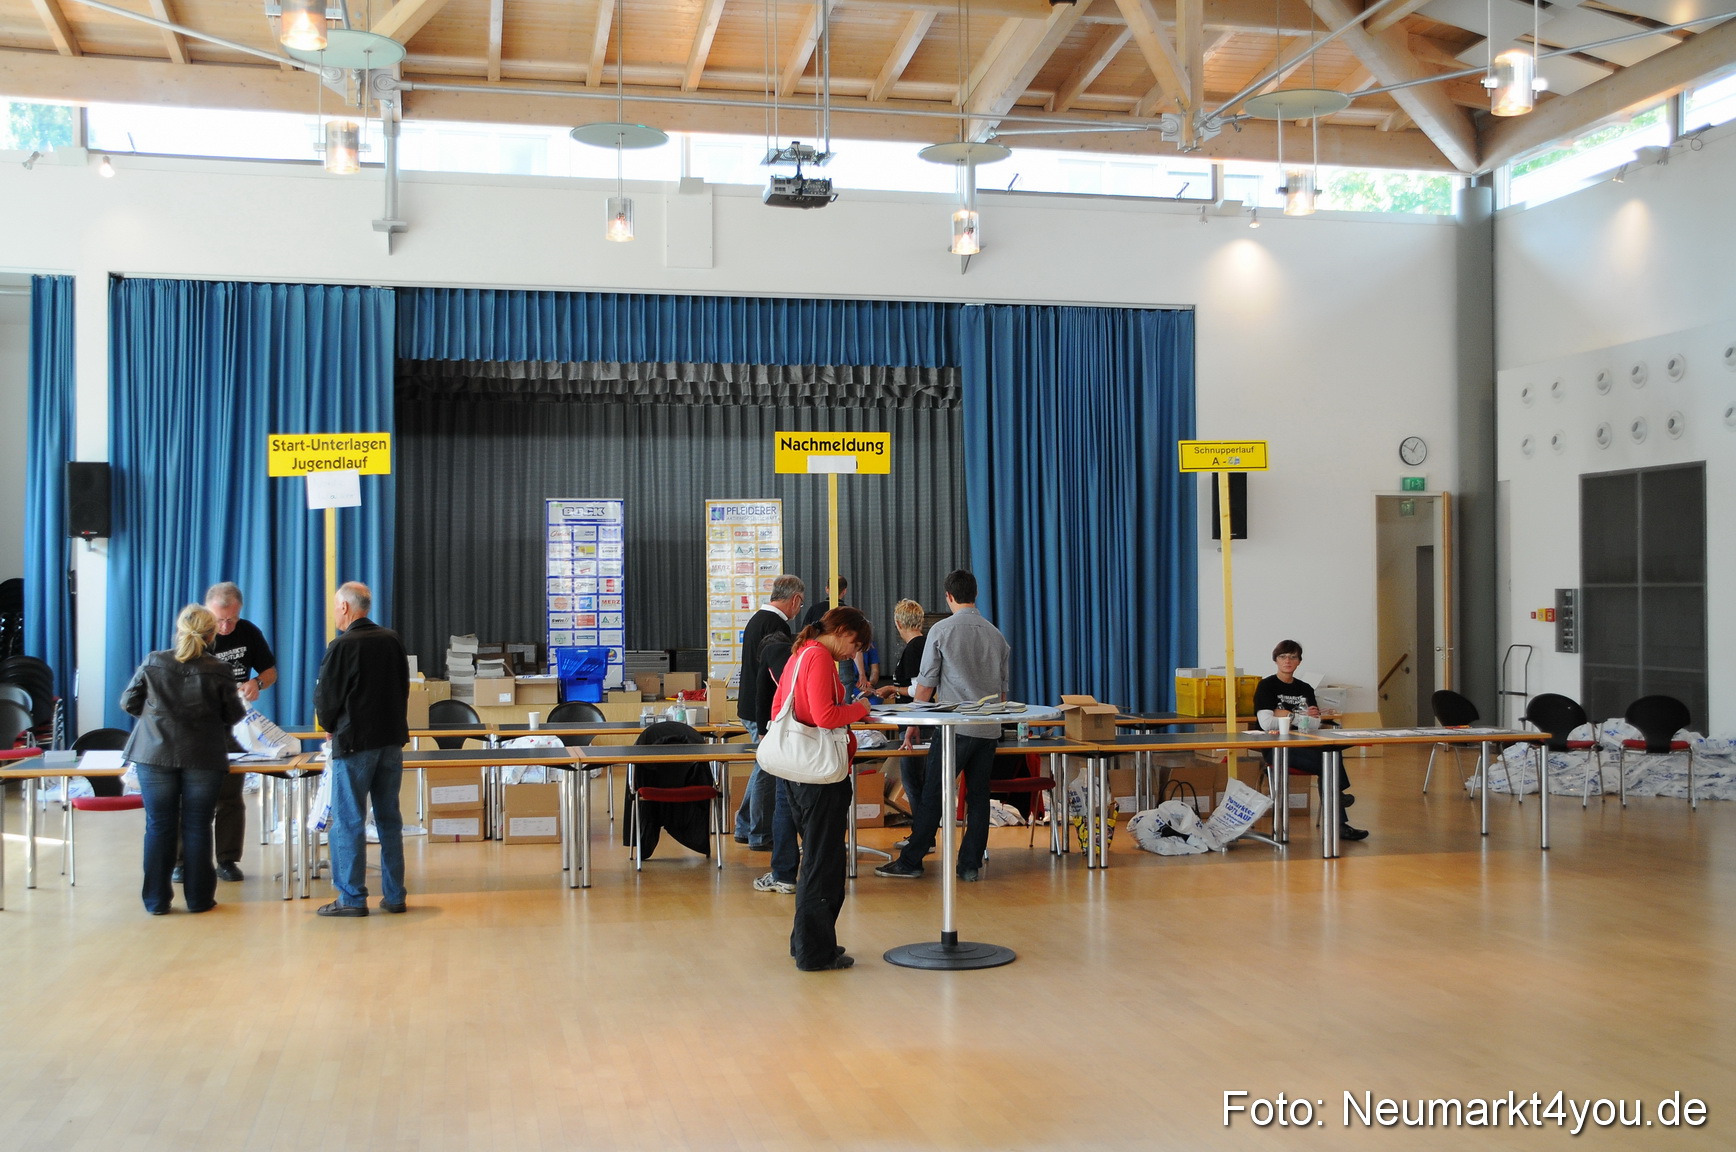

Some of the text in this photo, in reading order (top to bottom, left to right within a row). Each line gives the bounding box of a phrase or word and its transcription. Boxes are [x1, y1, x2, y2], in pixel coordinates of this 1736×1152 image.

[272, 438, 387, 453] Start-Unterlagen
[780, 437, 884, 456] Nachmeldung
[1194, 446, 1255, 455] Schnupperlauf
[292, 456, 368, 472] Jugendlauf
[1212, 457, 1220, 466] A
[726, 506, 777, 516] PFLEIDERER
